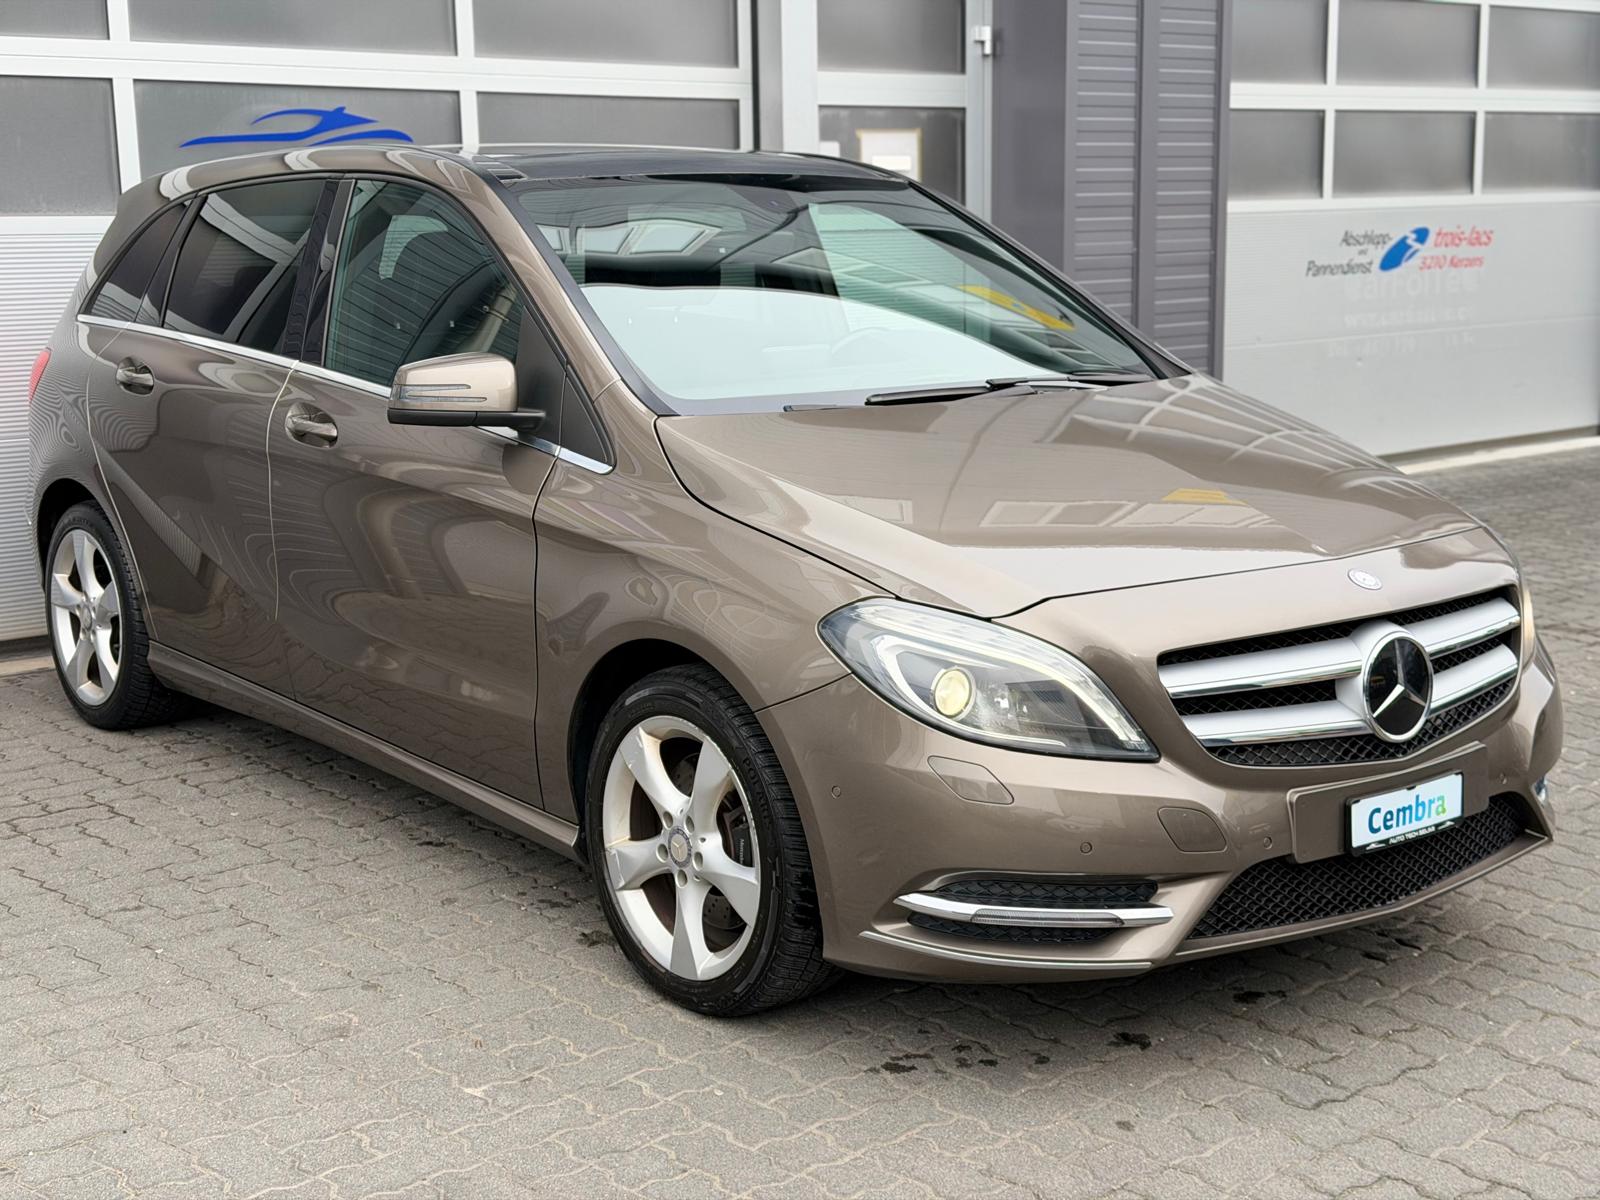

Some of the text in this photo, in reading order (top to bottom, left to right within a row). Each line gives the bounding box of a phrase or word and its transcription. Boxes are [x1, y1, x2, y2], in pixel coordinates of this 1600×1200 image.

[1433, 224, 1494, 248] trois-lacs
[1305, 258, 1373, 277] Pannendienst
[1368, 794, 1447, 834] Cembra
[1389, 834, 1405, 845] AUTO
